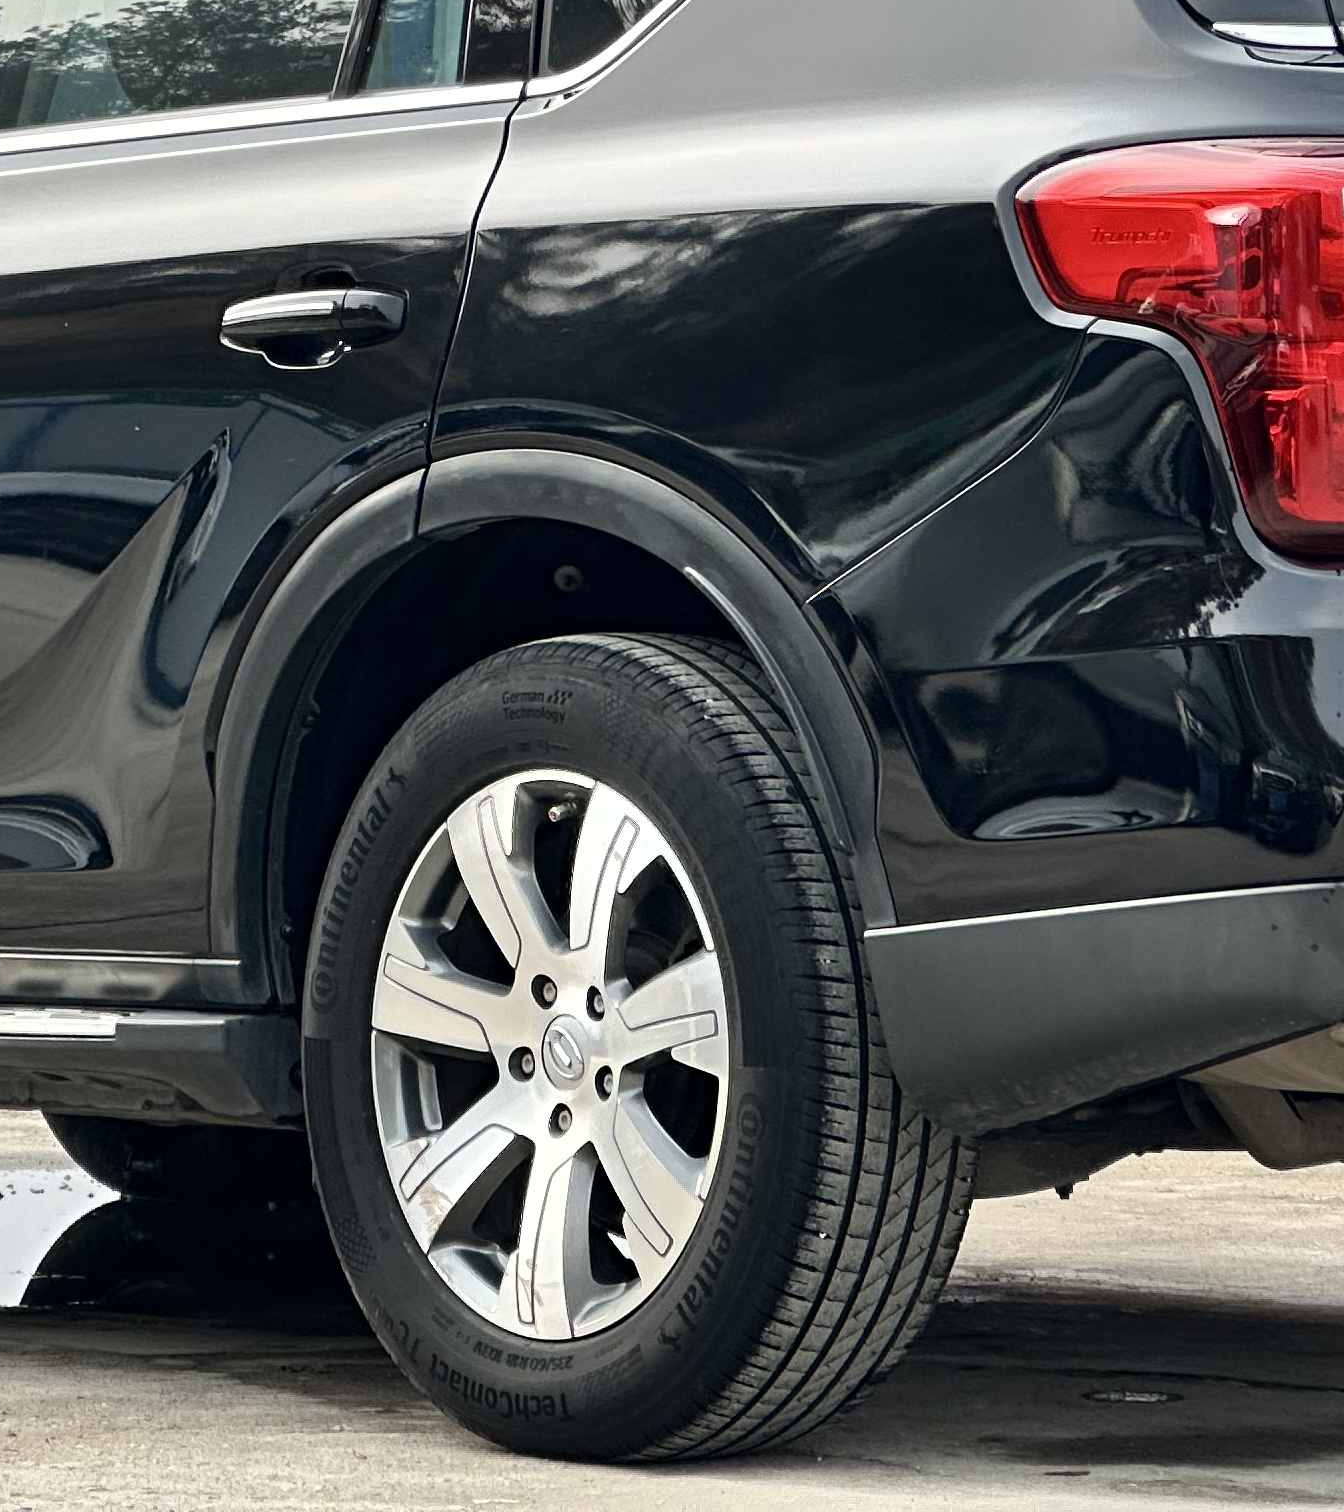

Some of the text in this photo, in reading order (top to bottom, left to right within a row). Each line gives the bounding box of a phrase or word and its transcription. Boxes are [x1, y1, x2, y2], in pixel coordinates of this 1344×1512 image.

[501, 690, 545, 704] German
[502, 706, 566, 725] Technology
[311, 785, 393, 1014] Continental
[677, 1092, 763, 1332] Continental
[425, 1353, 576, 1423] TechContact
